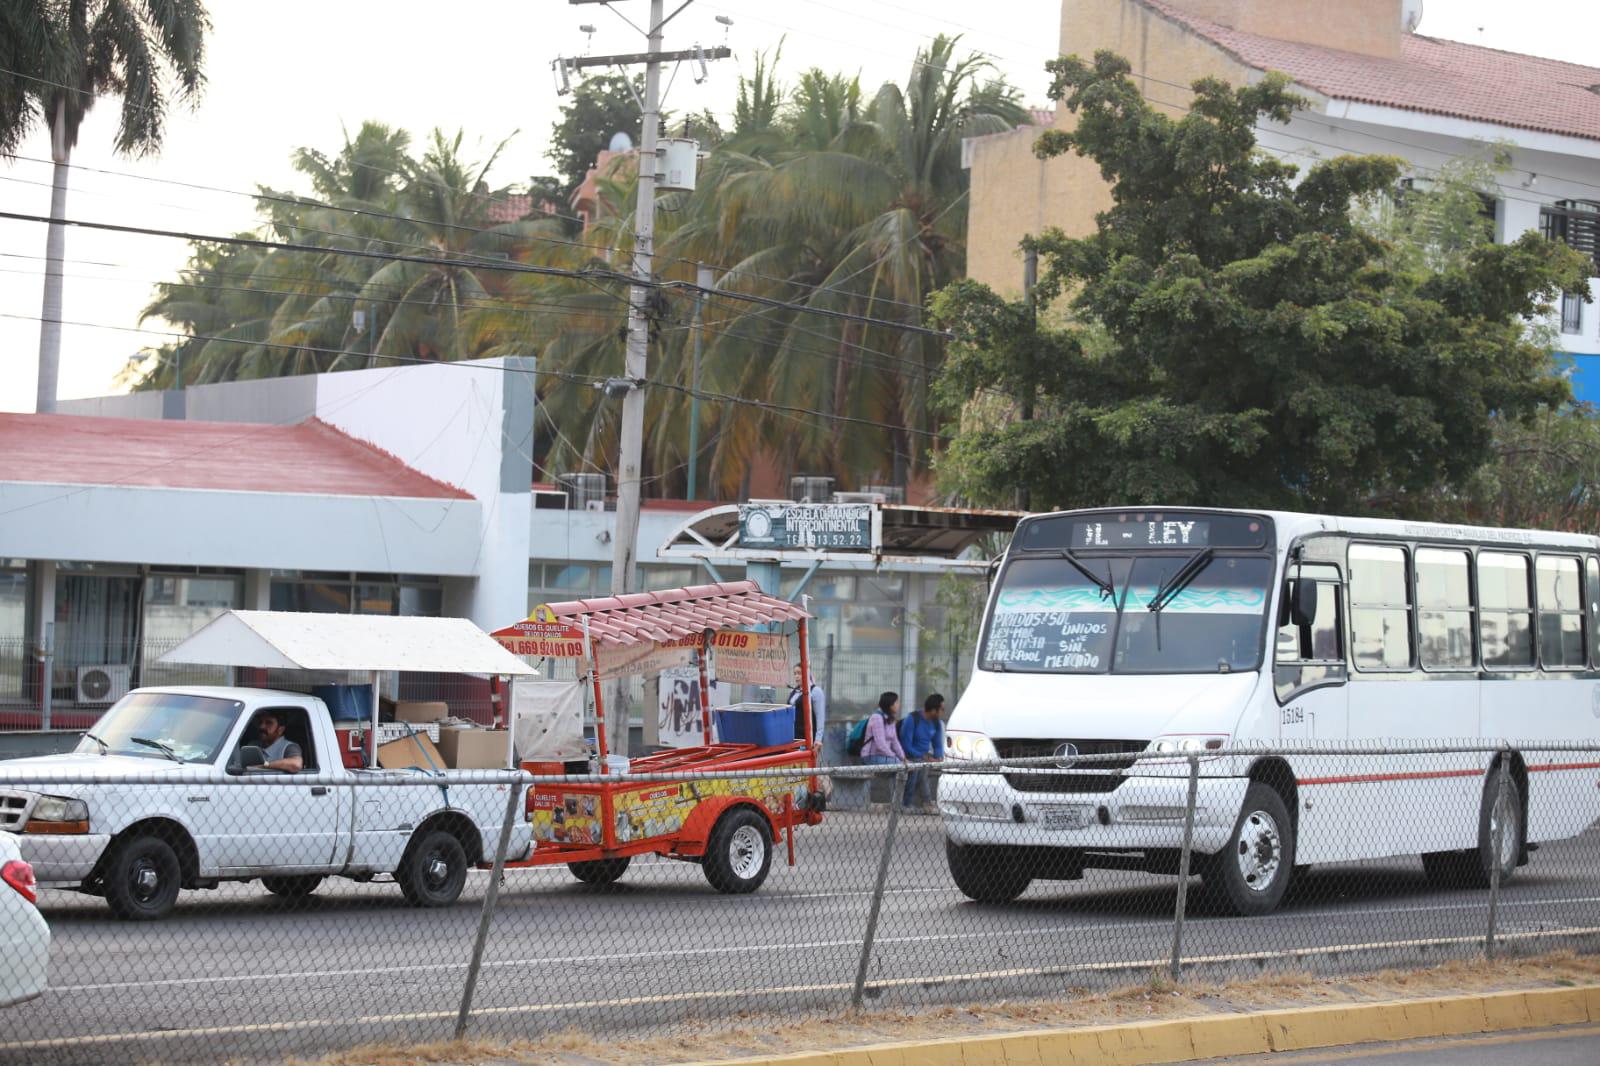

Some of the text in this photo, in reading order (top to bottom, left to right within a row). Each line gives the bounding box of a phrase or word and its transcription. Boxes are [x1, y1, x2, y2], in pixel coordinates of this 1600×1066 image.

[786, 519, 861, 532] INTERCONTINENTAL
[1148, 521, 1195, 544] LEY
[518, 640, 538, 655] 669
[732, 634, 748, 648] 09
[1282, 707, 1304, 725] 15184
